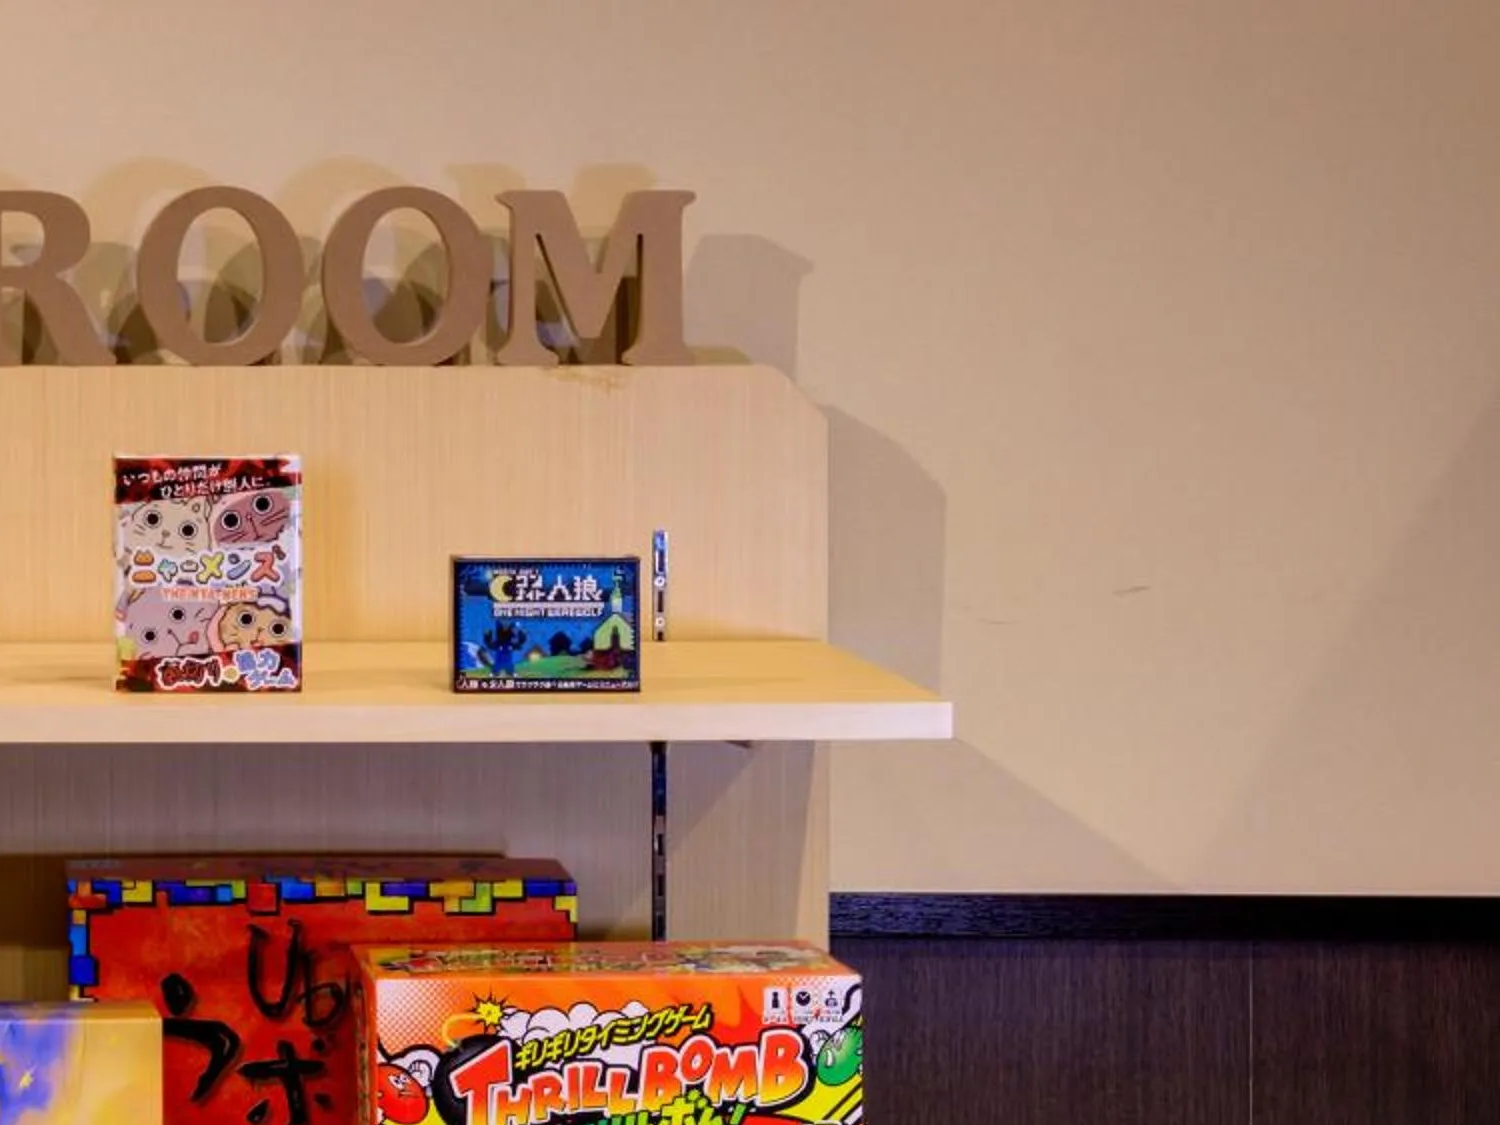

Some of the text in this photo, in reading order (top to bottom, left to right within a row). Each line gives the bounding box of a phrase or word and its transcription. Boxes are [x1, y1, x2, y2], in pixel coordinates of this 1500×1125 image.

[121, 463, 222, 485] いつもの仲間が
[131, 543, 286, 585] ニャーメンズ
[546, 574, 603, 601] 人狼
[514, 1004, 713, 1070] ギリギリタイミングゲーム
